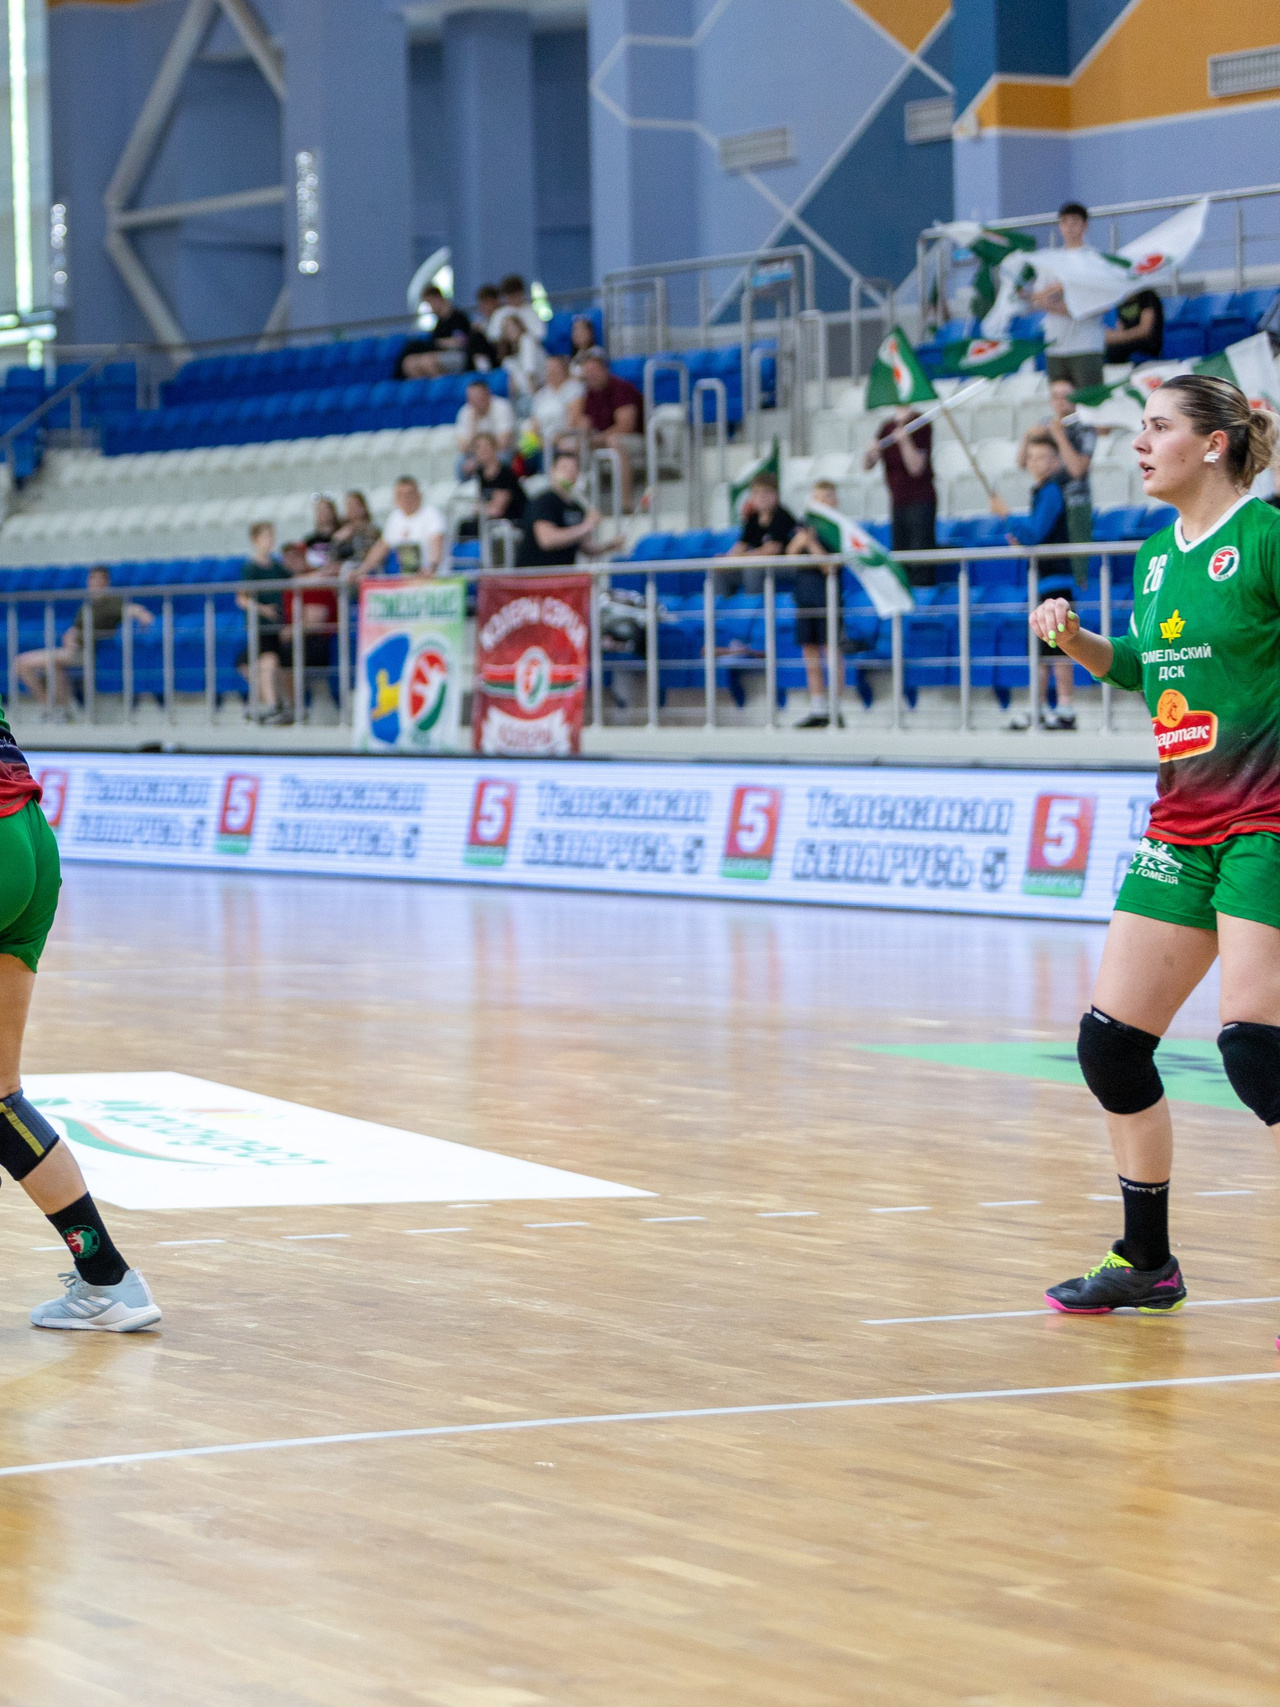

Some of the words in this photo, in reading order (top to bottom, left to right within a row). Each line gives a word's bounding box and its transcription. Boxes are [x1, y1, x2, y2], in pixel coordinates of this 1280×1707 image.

[1143, 554, 1168, 595] 26
[1141, 643, 1212, 664] ОМЕЛЬСКИЙ
[1158, 665, 1185, 681] ДСК
[1153, 724, 1210, 749] артак
[226, 778, 254, 832] 5
[476, 784, 510, 842] 5
[736, 792, 770, 853] 5
[1041, 799, 1081, 867] 5
[792, 839, 971, 889] БЕЛАРУСЬ
[980, 847, 1008, 892] 5
[1135, 867, 1179, 885] ГОМЕЛЯ
